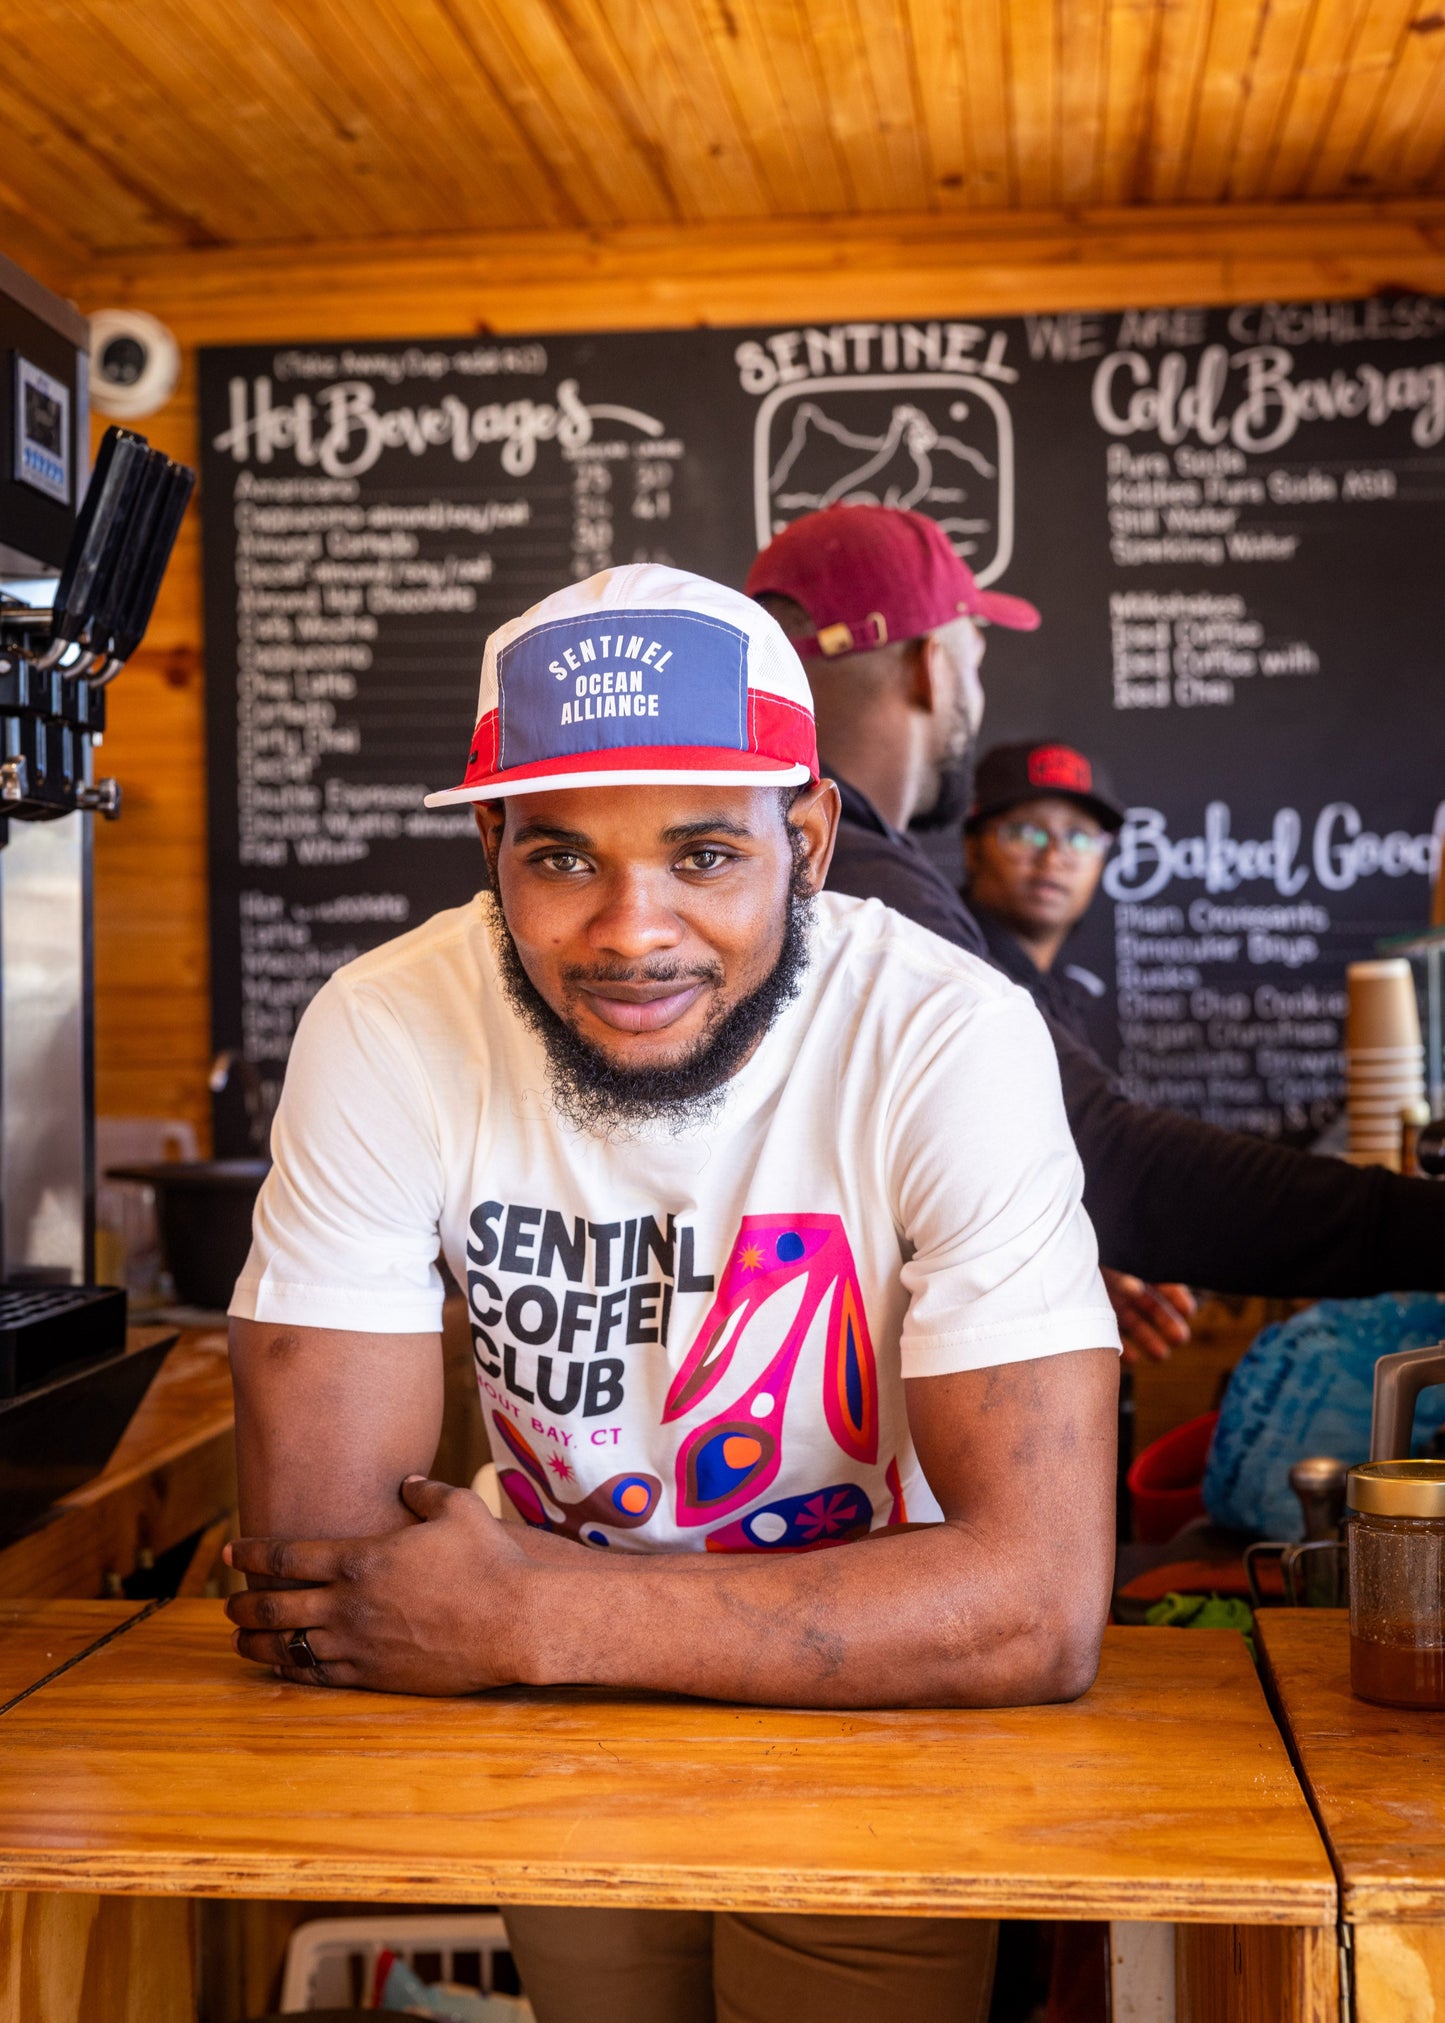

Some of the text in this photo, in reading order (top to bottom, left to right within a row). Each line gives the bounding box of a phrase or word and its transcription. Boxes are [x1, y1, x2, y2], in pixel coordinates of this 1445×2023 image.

[734, 323, 1020, 395] SENTINEL
[1025, 312, 1104, 361] WE
[1115, 307, 1207, 347] ARE
[213, 375, 664, 478] Hot Beverages
[1091, 343, 1229, 444] Cold
[549, 635, 673, 681] SENTINEL
[575, 670, 643, 697] OCEAN
[561, 694, 659, 725] ALLIANCE
[1102, 800, 1309, 902] Baked
[467, 1200, 714, 1293] SENTINL
[471, 1323, 625, 1417] CLUB
[591, 1428, 622, 1445] CT
